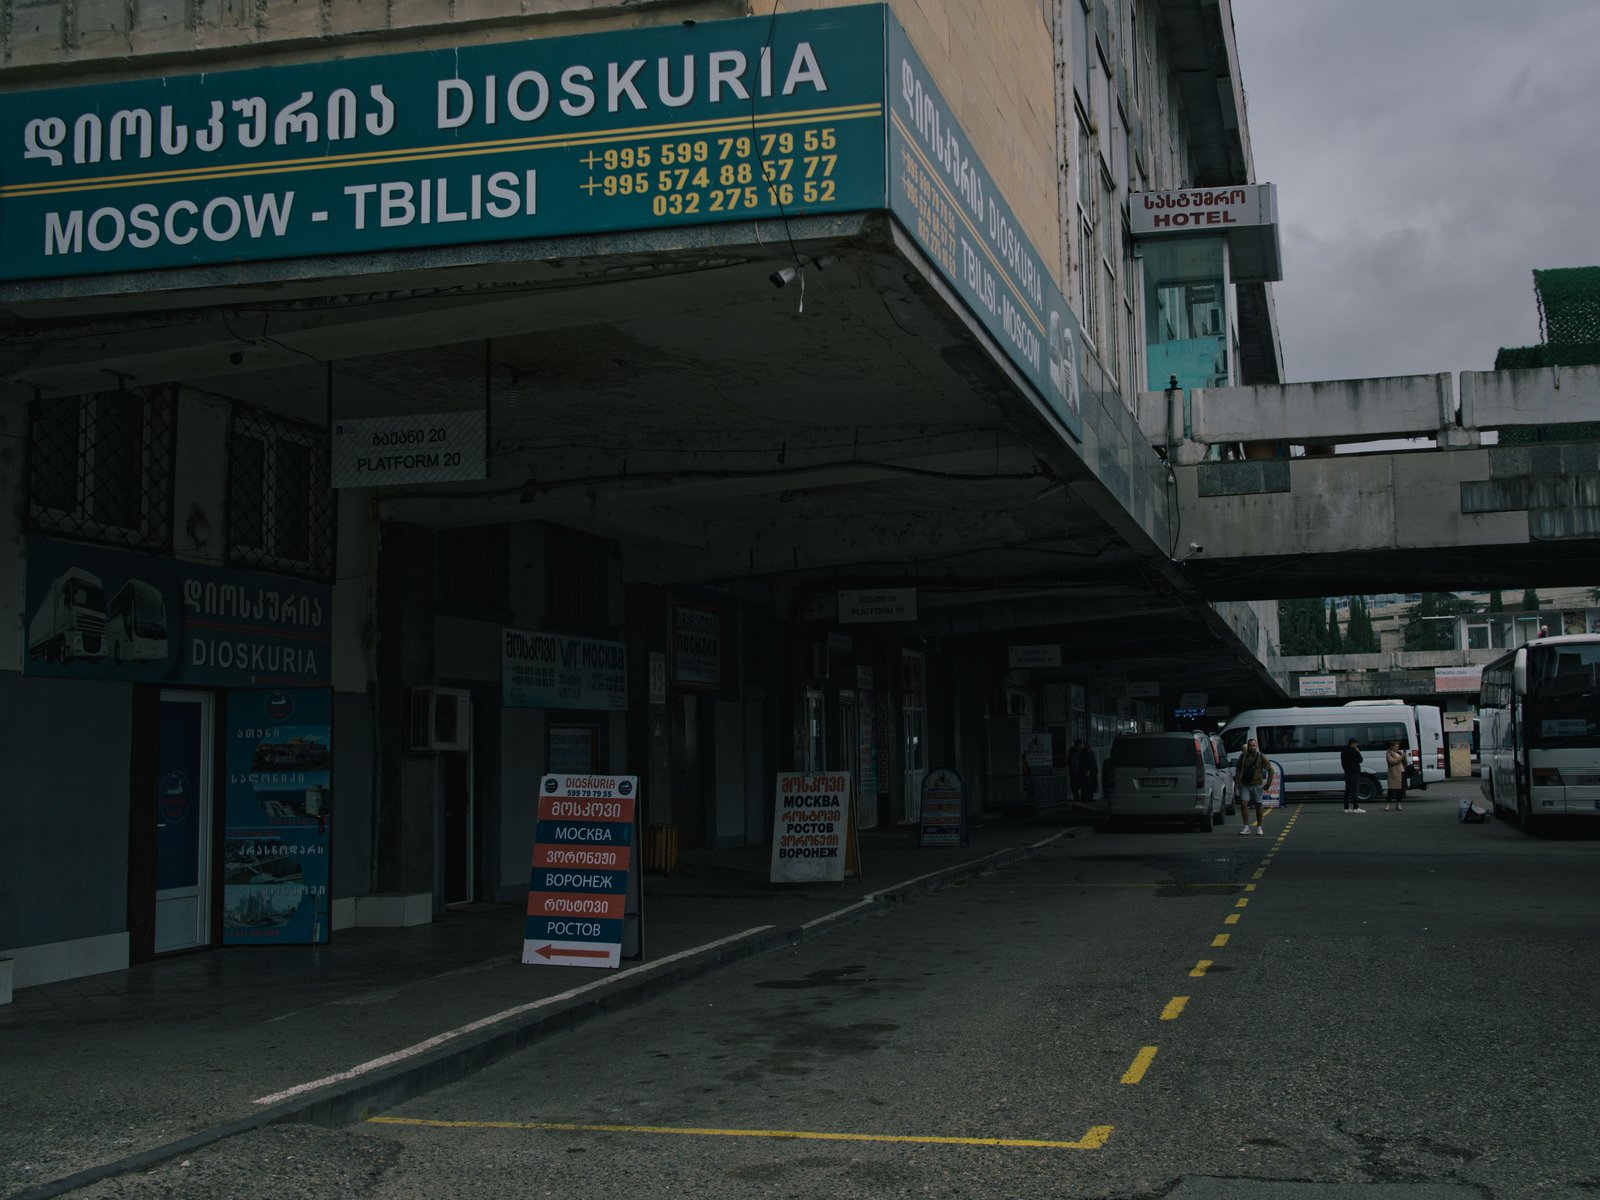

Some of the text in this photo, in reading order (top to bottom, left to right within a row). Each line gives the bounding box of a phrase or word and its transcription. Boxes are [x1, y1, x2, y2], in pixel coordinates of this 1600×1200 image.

[23, 42, 828, 167] დიოსკურია DIOSKURIA
[580, 128, 836, 170] +995 599 79 79 55
[580, 154, 837, 197] +995 574 88 57 77
[902, 57, 1043, 311] დიოსკურია DIOSKURIA
[653, 179, 836, 216] 032 275 16 52
[1144, 189, 1245, 210] სასტუმრო
[43, 191, 295, 256] MOSCOW
[344, 169, 537, 230] TBILISI
[1153, 211, 1236, 227] HOTEL
[961, 236, 997, 318] TBILISI
[1002, 295, 1041, 373] MOSCOW
[372, 429, 425, 446] ბაქანი
[429, 428, 446, 442] 20
[357, 452, 460, 472] PLATFORM 20
[184, 578, 323, 627] დიოსკურია
[850, 607, 894, 616] PLATFORM
[506, 632, 556, 662] მოსკოვი
[678, 634, 718, 656] ПОСЫЛКИ
[192, 638, 318, 675] DIOSKURIA
[565, 777, 616, 789] DIOSKURIA
[781, 776, 845, 793] მოსკოვი
[567, 789, 581, 797] 599
[582, 789, 591, 797] 79
[603, 790, 612, 798] 55
[784, 795, 839, 808] МОСКВА
[551, 801, 621, 818] მოსკოვი
[781, 810, 841, 823] როსტოვი
[555, 827, 612, 841] МОСКВА
[786, 823, 834, 834] РОСТОВ
[780, 835, 839, 847] ვორონეჟი
[546, 850, 616, 865] ვორონეჟი
[779, 847, 838, 858] ВОРОНЕЖ
[545, 873, 613, 889] ВОРОНЕЖ
[544, 898, 609, 914] როსტოვი
[547, 921, 601, 937] РОСТОВ
